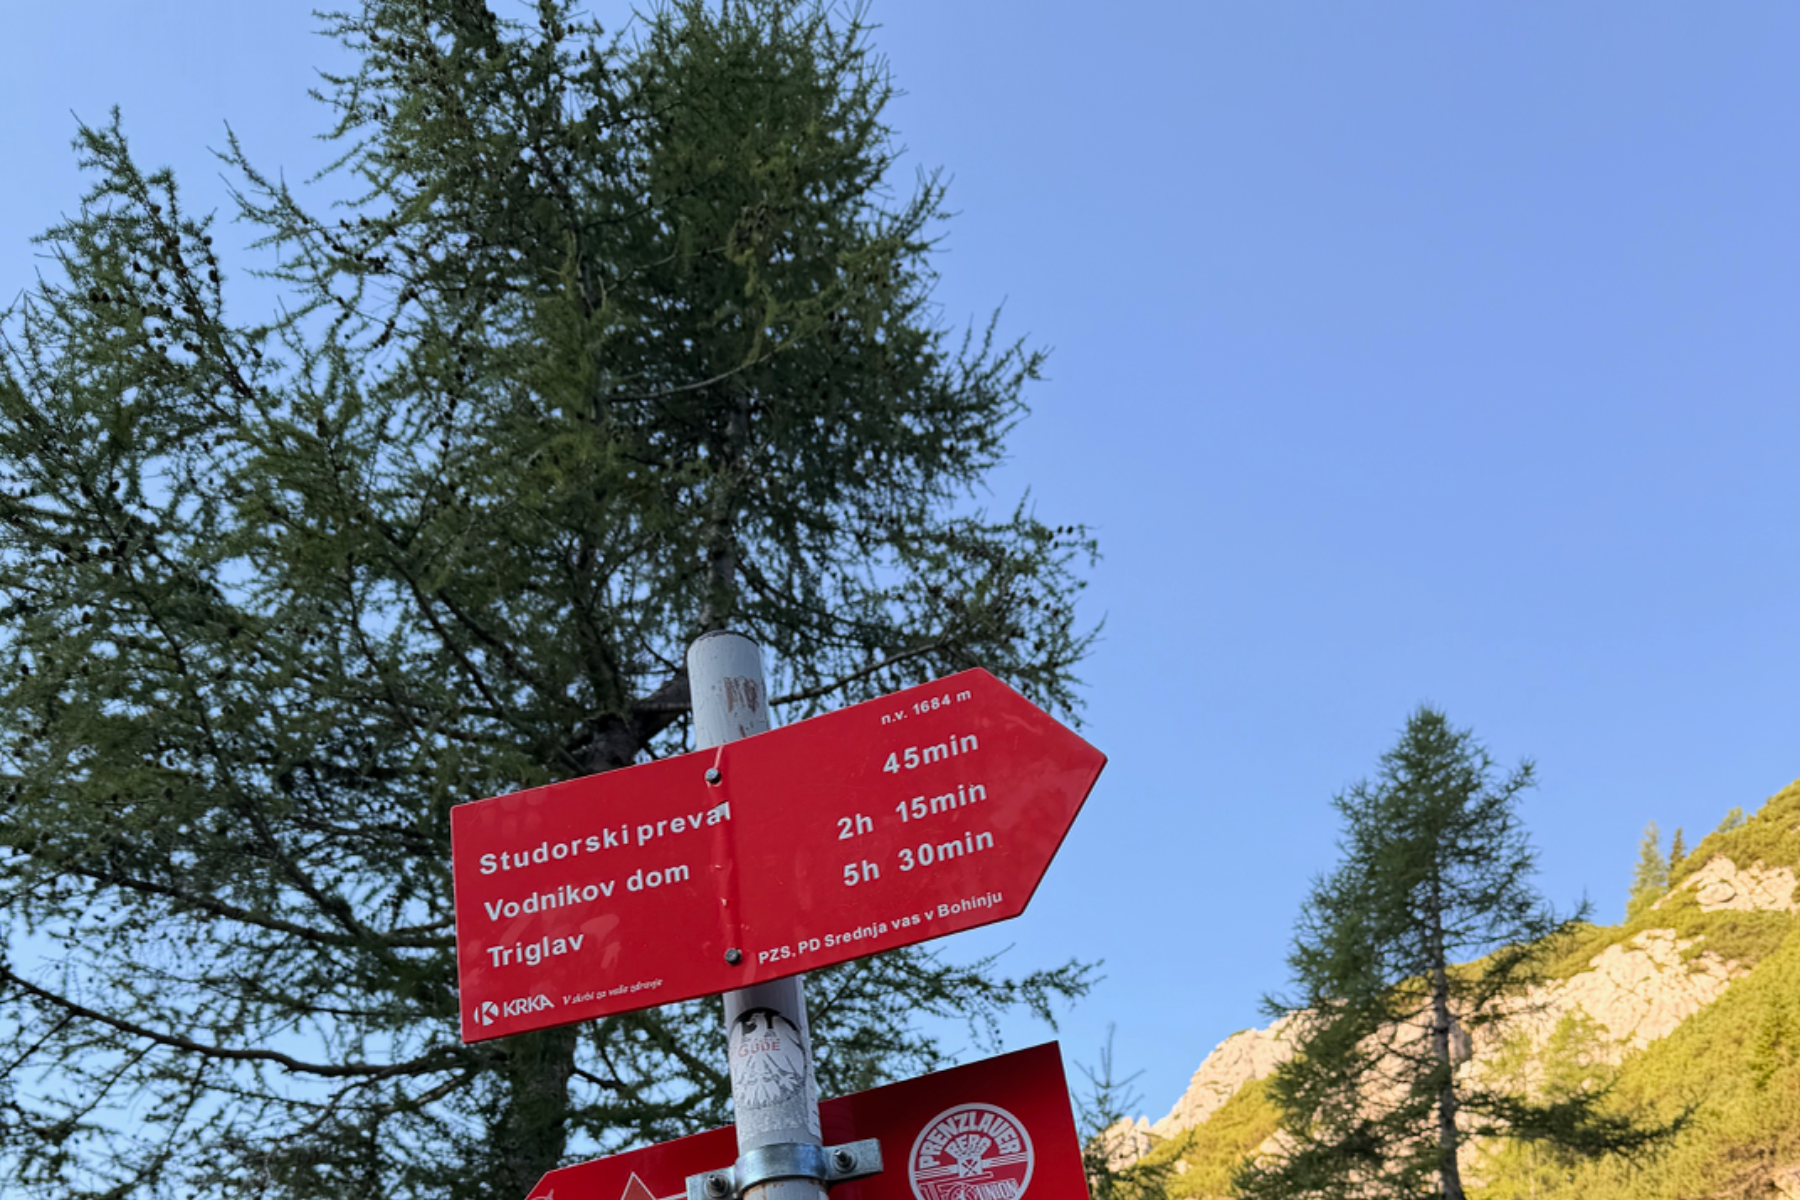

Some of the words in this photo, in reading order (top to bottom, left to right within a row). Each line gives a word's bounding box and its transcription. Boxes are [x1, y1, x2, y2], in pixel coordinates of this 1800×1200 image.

[880, 711, 908, 725] n.v.
[912, 694, 951, 716] 1684
[956, 690, 972, 703] m
[883, 733, 979, 774] 45min
[479, 824, 629, 875] Studorski
[637, 801, 731, 846] preval
[837, 813, 874, 840] 2h
[896, 783, 987, 822] 15min
[843, 859, 880, 886] 5h
[898, 830, 994, 871] 30min
[484, 880, 615, 922] Vodnikov
[626, 864, 690, 892] dom
[487, 933, 584, 968] Triglav
[798, 936, 821, 954] PD
[824, 922, 888, 948] Srednja
[891, 914, 921, 930] vas
[924, 909, 934, 922] v
[937, 892, 1003, 918] Bohinju
[503, 993, 555, 1018] KRKA
[919, 1111, 1021, 1169] PRENZLAUER
